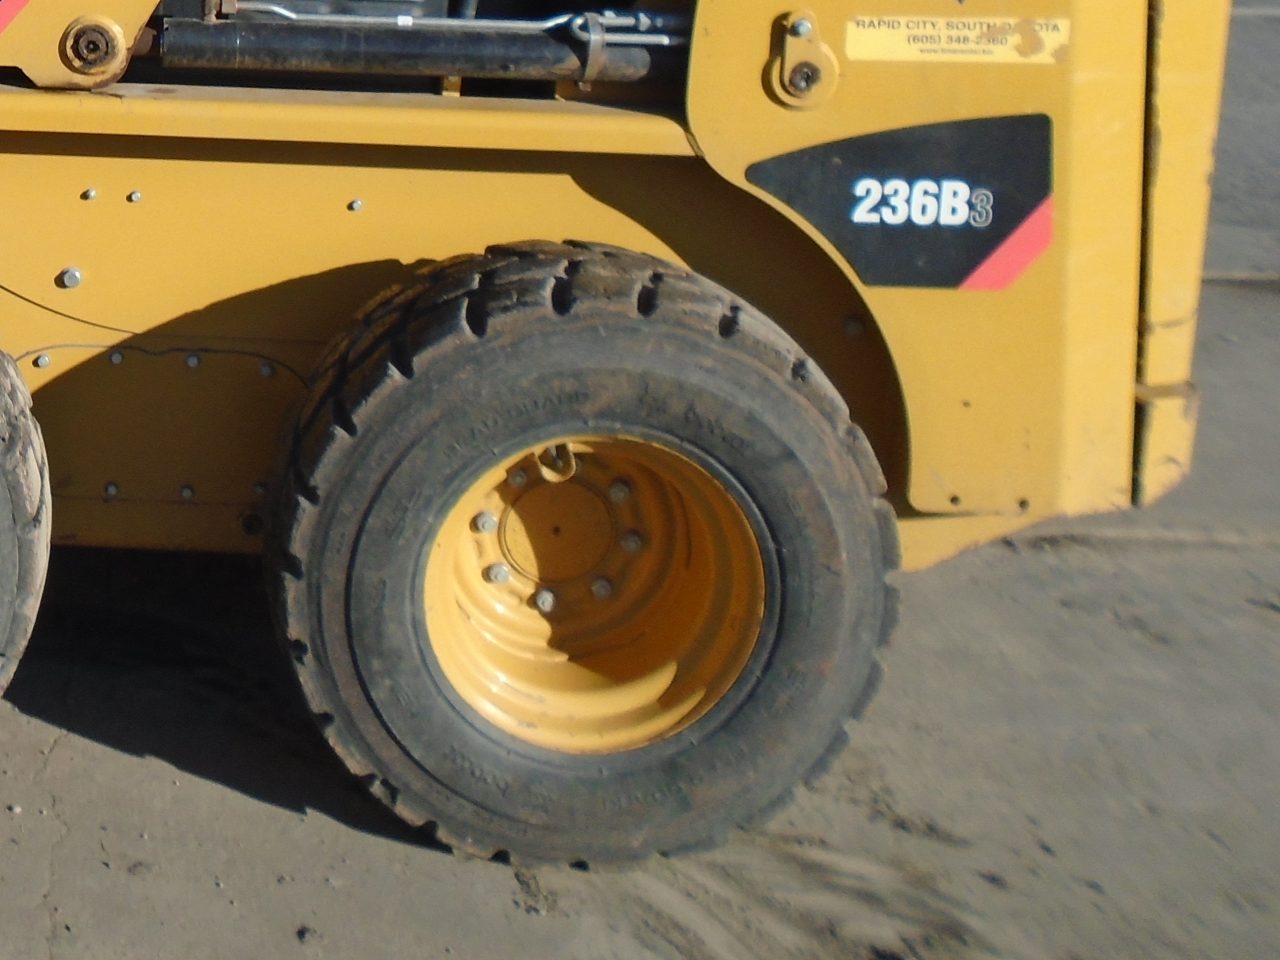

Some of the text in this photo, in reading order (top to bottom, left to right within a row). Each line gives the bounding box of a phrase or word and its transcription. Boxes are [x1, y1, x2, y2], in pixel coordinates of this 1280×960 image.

[856, 19, 902, 31] RAPID
[945, 20, 997, 32] SOUTH
[1004, 23, 1061, 34] DOTA
[907, 35, 943, 47] (605)
